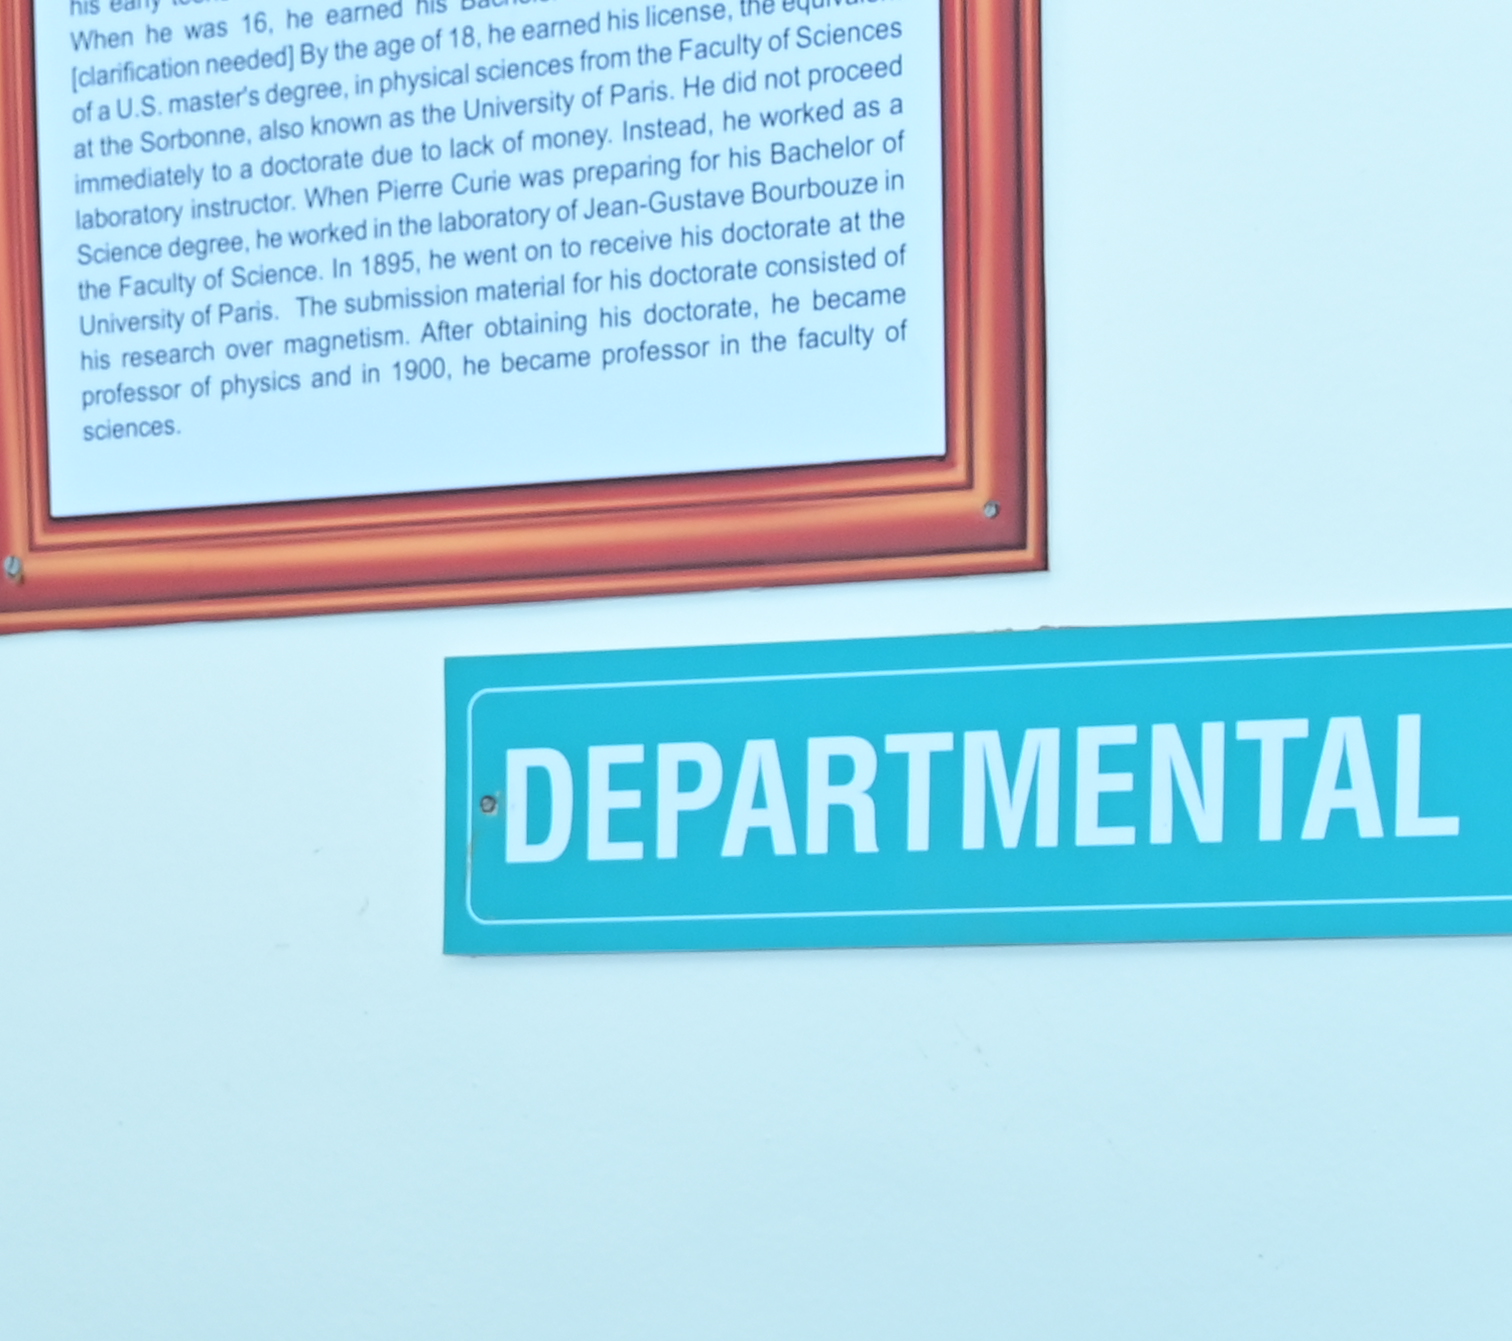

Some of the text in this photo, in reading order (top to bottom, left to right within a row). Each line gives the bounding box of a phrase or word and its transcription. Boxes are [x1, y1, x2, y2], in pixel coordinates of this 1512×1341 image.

[69, 29, 134, 52] When
[145, 23, 173, 45] he
[183, 20, 229, 41] was
[242, 10, 274, 35] 16,
[286, 8, 314, 30] he
[325, 0, 404, 26] earned
[415, 0, 448, 16] his
[72, 20, 903, 125] of a U.S. master's degree, in physical sciences from the Faculty of Sciences
[74, 97, 904, 195] immediately to a doctorate due to lack of money. Instead, he worked as a
[77, 207, 906, 302] the Faculty of Science. In 1895, he went on to receive his doctorate at the
[80, 286, 907, 371] his research over magnetism. After obtaining his doctorate, he became
[81, 317, 908, 411] professor of physics and in 1900, he became professor in the faculty of
[82, 416, 182, 442] sciences.
[504, 712, 1460, 865] DEPARTMENTAL
